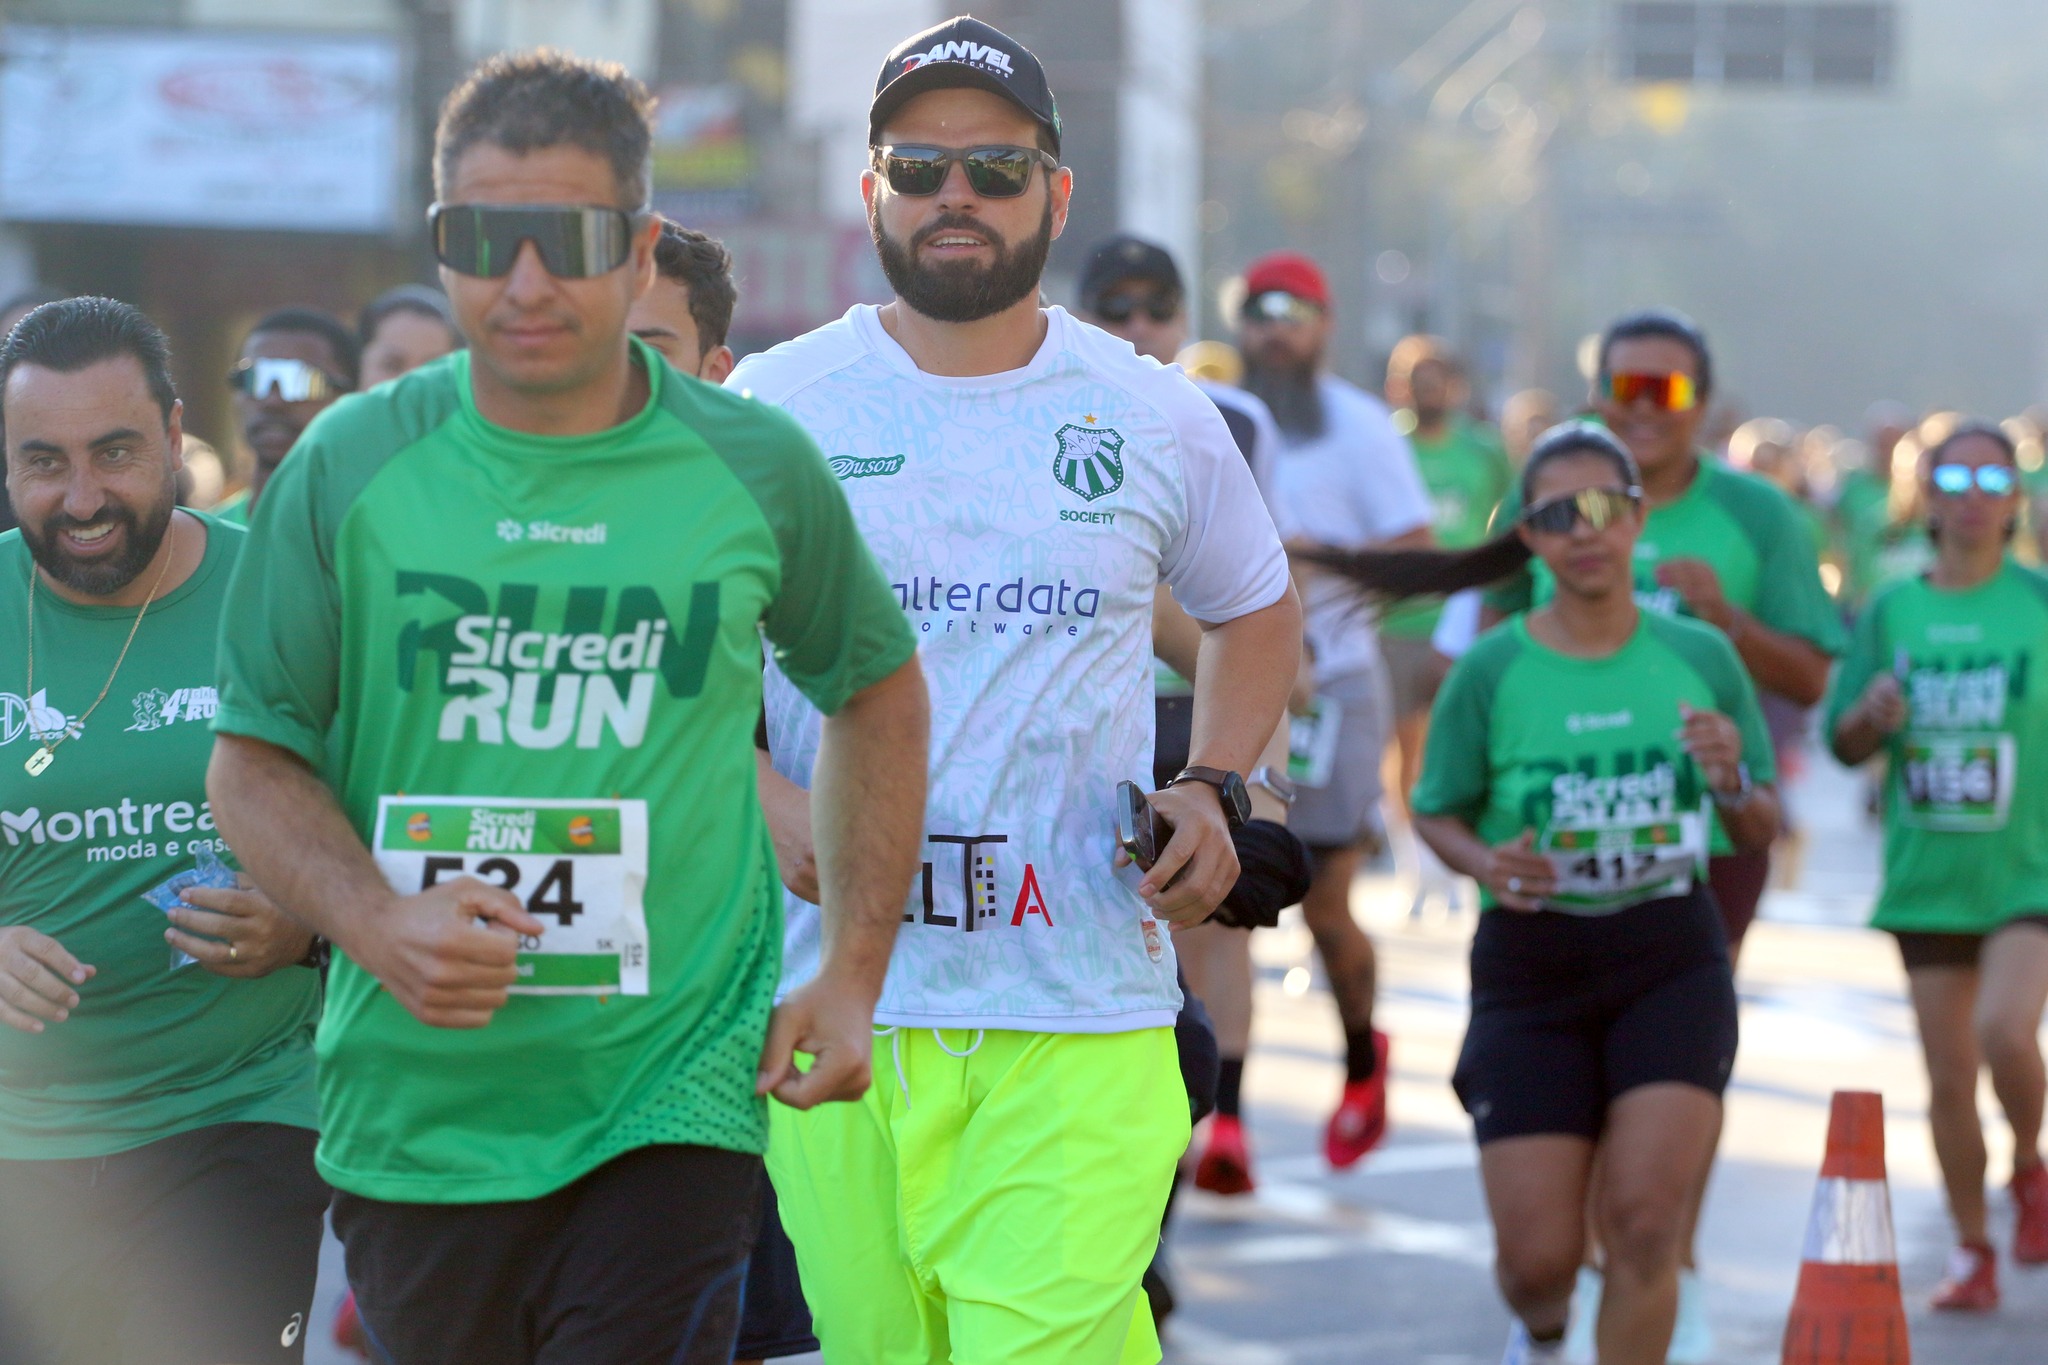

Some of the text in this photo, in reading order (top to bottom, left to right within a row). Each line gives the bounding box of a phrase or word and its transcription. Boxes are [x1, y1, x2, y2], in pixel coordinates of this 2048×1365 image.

[901, 41, 1014, 73] DANVEL
[1059, 509, 1116, 525] SOCIETY
[527, 520, 607, 544] Sicredi
[920, 619, 1078, 637] oftware
[451, 615, 668, 671] Sicredi
[185, 702, 218, 722] RU
[437, 666, 656, 750] RUN
[0, 797, 216, 846] Montrea
[470, 808, 537, 830] Sicredi
[466, 823, 534, 852] RUN
[87, 839, 157, 862] moda
[165, 841, 180, 857] e
